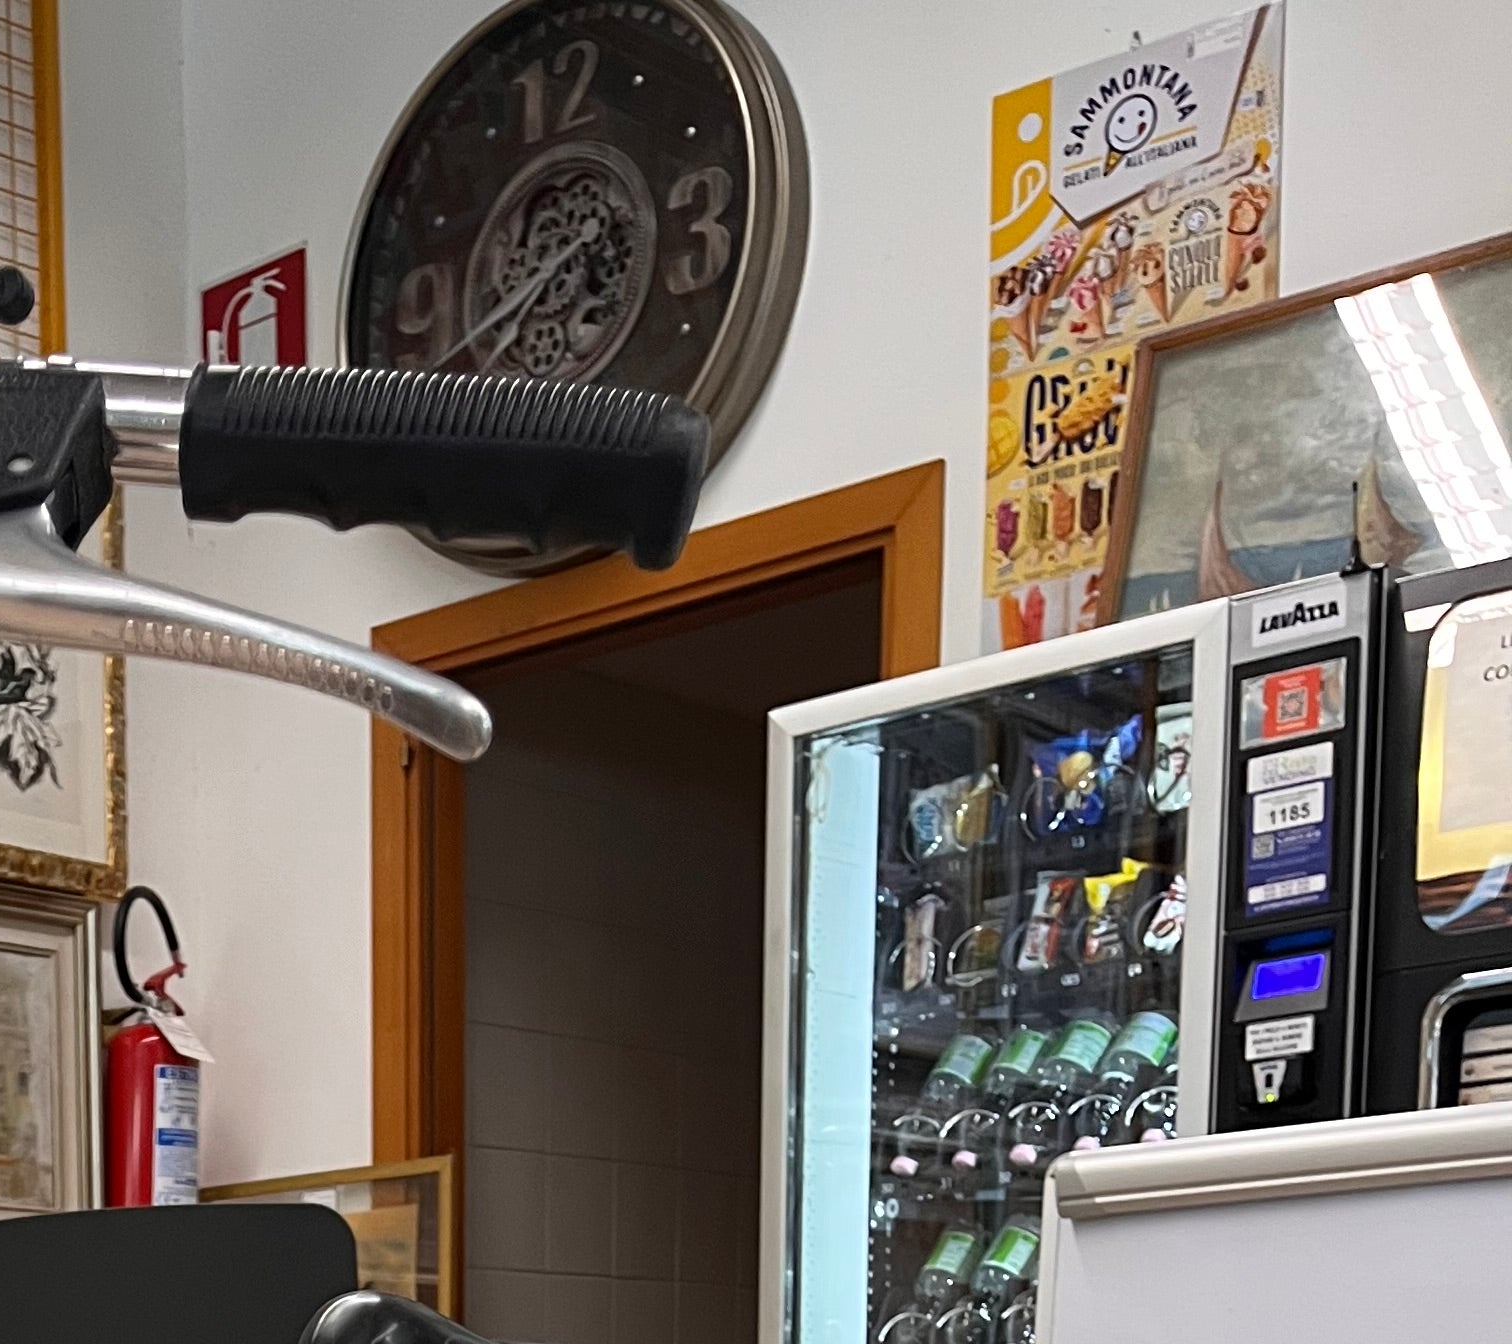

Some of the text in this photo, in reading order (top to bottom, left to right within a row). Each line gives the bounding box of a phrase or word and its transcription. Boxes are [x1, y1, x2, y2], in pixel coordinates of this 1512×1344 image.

[513, 39, 600, 144] 12
[1063, 63, 1198, 157] SAMMONTANA
[665, 166, 733, 296] 3
[1259, 601, 1339, 634] LAVAZZA
[1270, 802, 1311, 825] 1185
